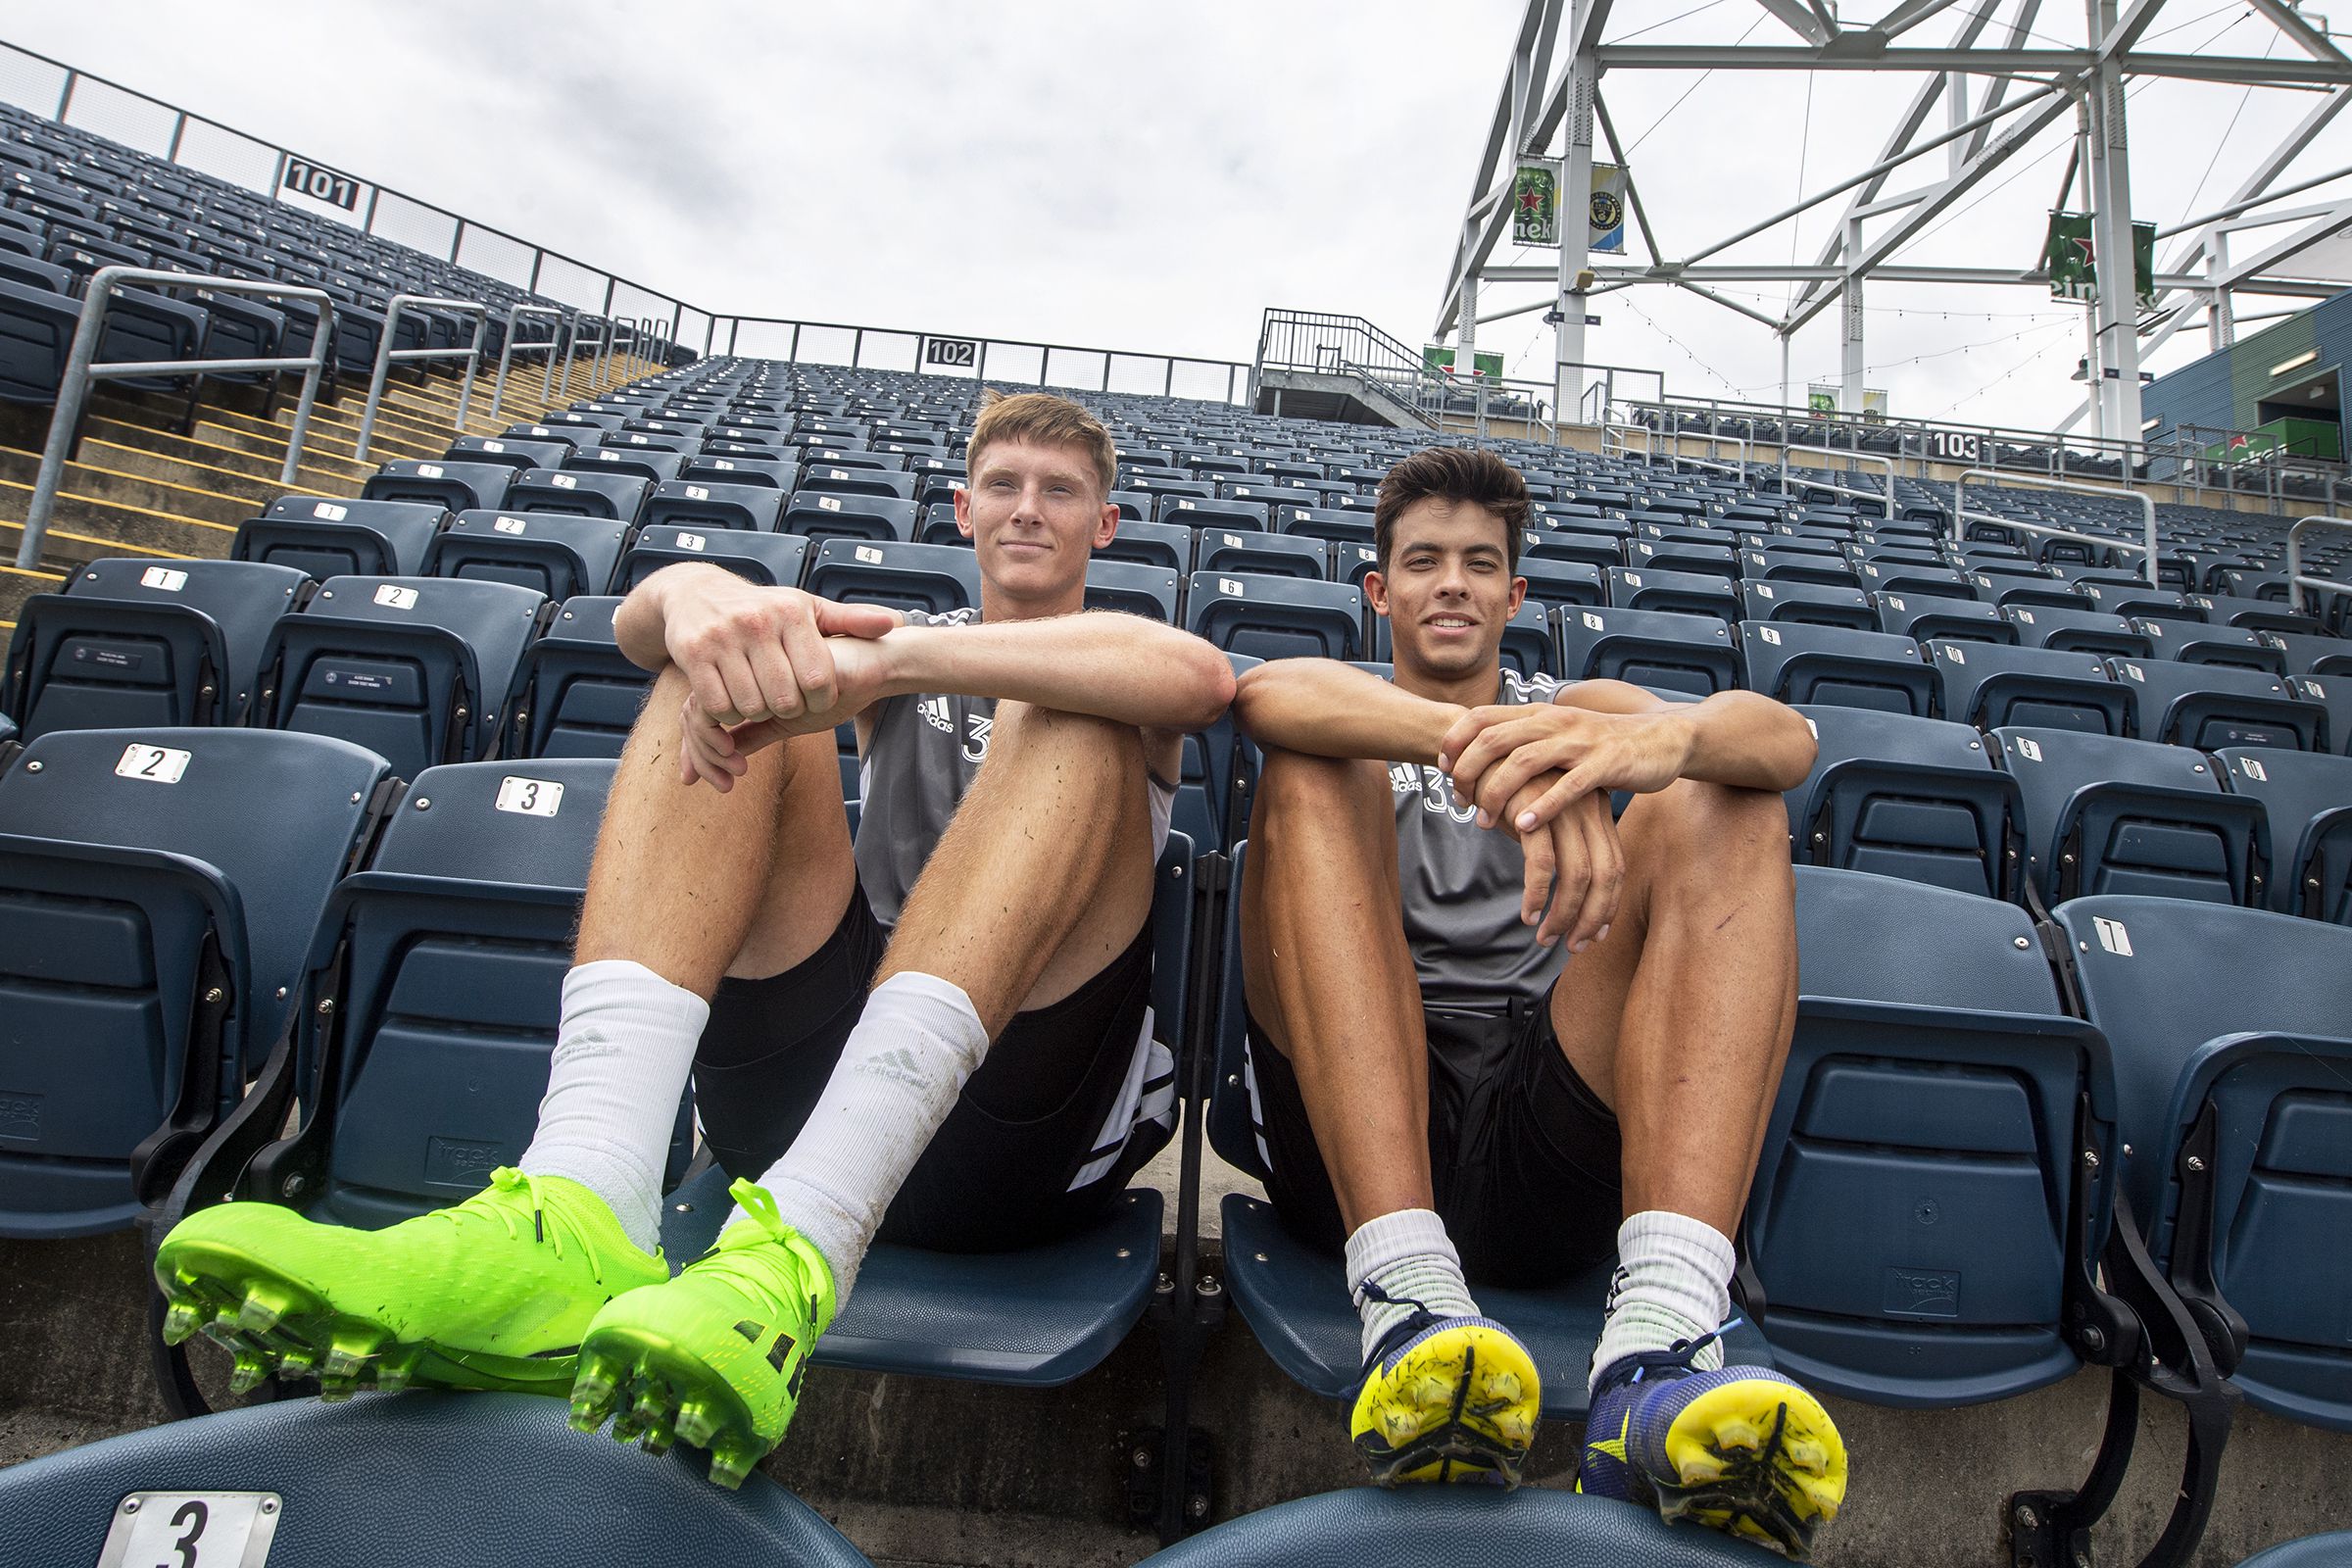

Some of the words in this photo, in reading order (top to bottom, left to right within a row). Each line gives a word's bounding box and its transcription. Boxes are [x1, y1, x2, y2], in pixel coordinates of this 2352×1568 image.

[292, 164, 351, 207] 101
[931, 341, 972, 365] 102
[1934, 432, 1977, 459] 103
[693, 488, 699, 497] 3
[826, 500, 832, 509] 4
[327, 508, 333, 516] 1
[506, 520, 515, 531] 2
[687, 536, 695, 547] 3
[1231, 536, 1235, 546] 7
[865, 550, 872, 561] 4
[161, 571, 170, 586] 1
[1628, 573, 1638, 586] 10
[1228, 582, 1235, 593] 6
[1761, 586, 1767, 595] 11
[388, 589, 402, 604] 2
[1891, 598, 1899, 609] 12
[1591, 616, 1595, 627] 8
[1767, 630, 1774, 642] 9
[1949, 648, 1960, 662] 10
[917, 700, 955, 733] adidas
[960, 713, 994, 762] 3
[2024, 740, 2032, 757] 9
[141, 751, 166, 776] 2
[2245, 760, 2260, 779] 10
[520, 782, 540, 809] 3
[156, 1499, 209, 1568] 3
